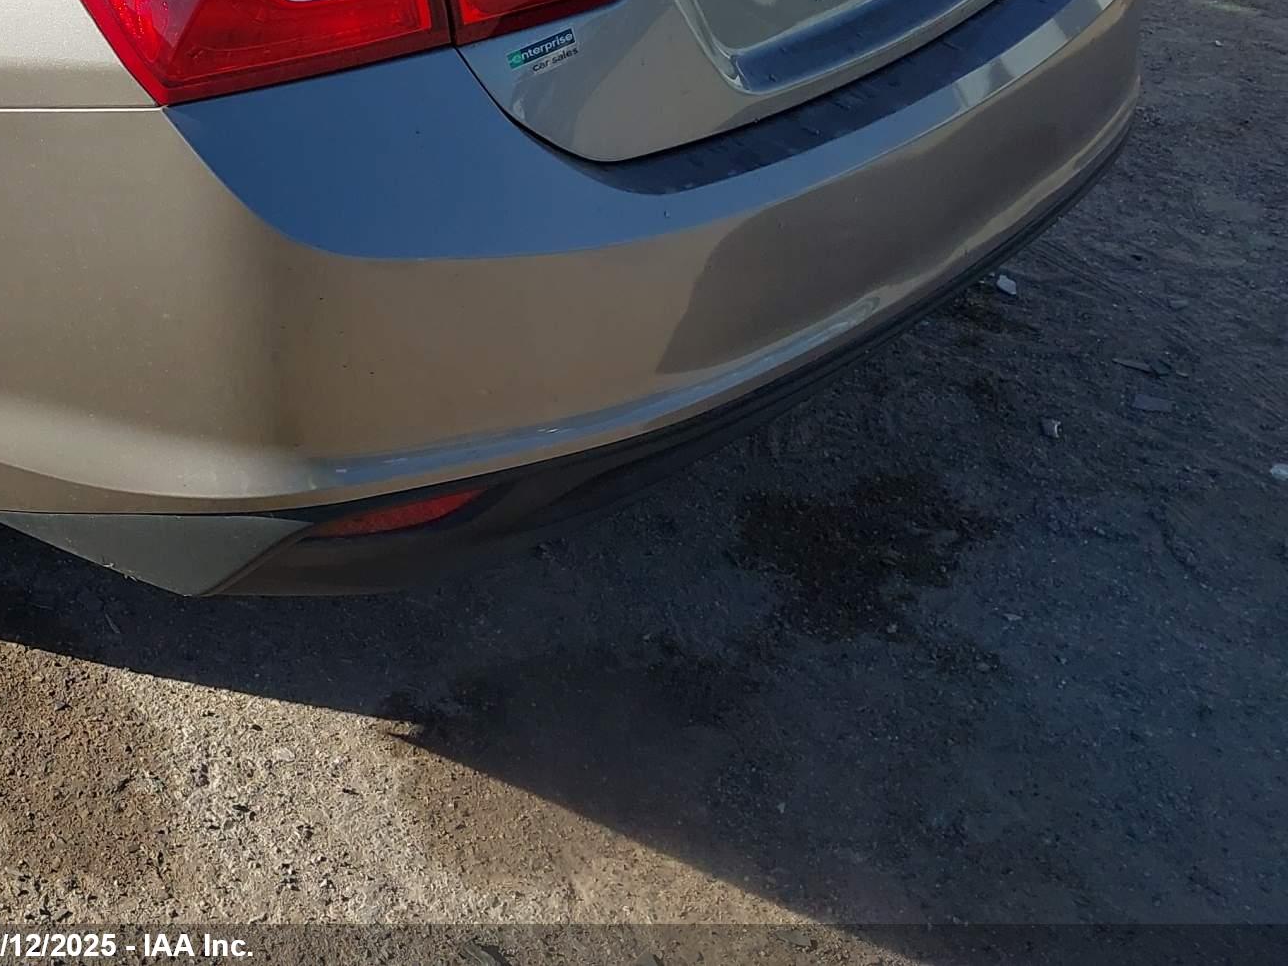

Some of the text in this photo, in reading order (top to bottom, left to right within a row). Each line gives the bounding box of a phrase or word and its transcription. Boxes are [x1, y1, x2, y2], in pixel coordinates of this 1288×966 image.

[509, 33, 574, 65] enterprise
[532, 47, 579, 72] car sales
